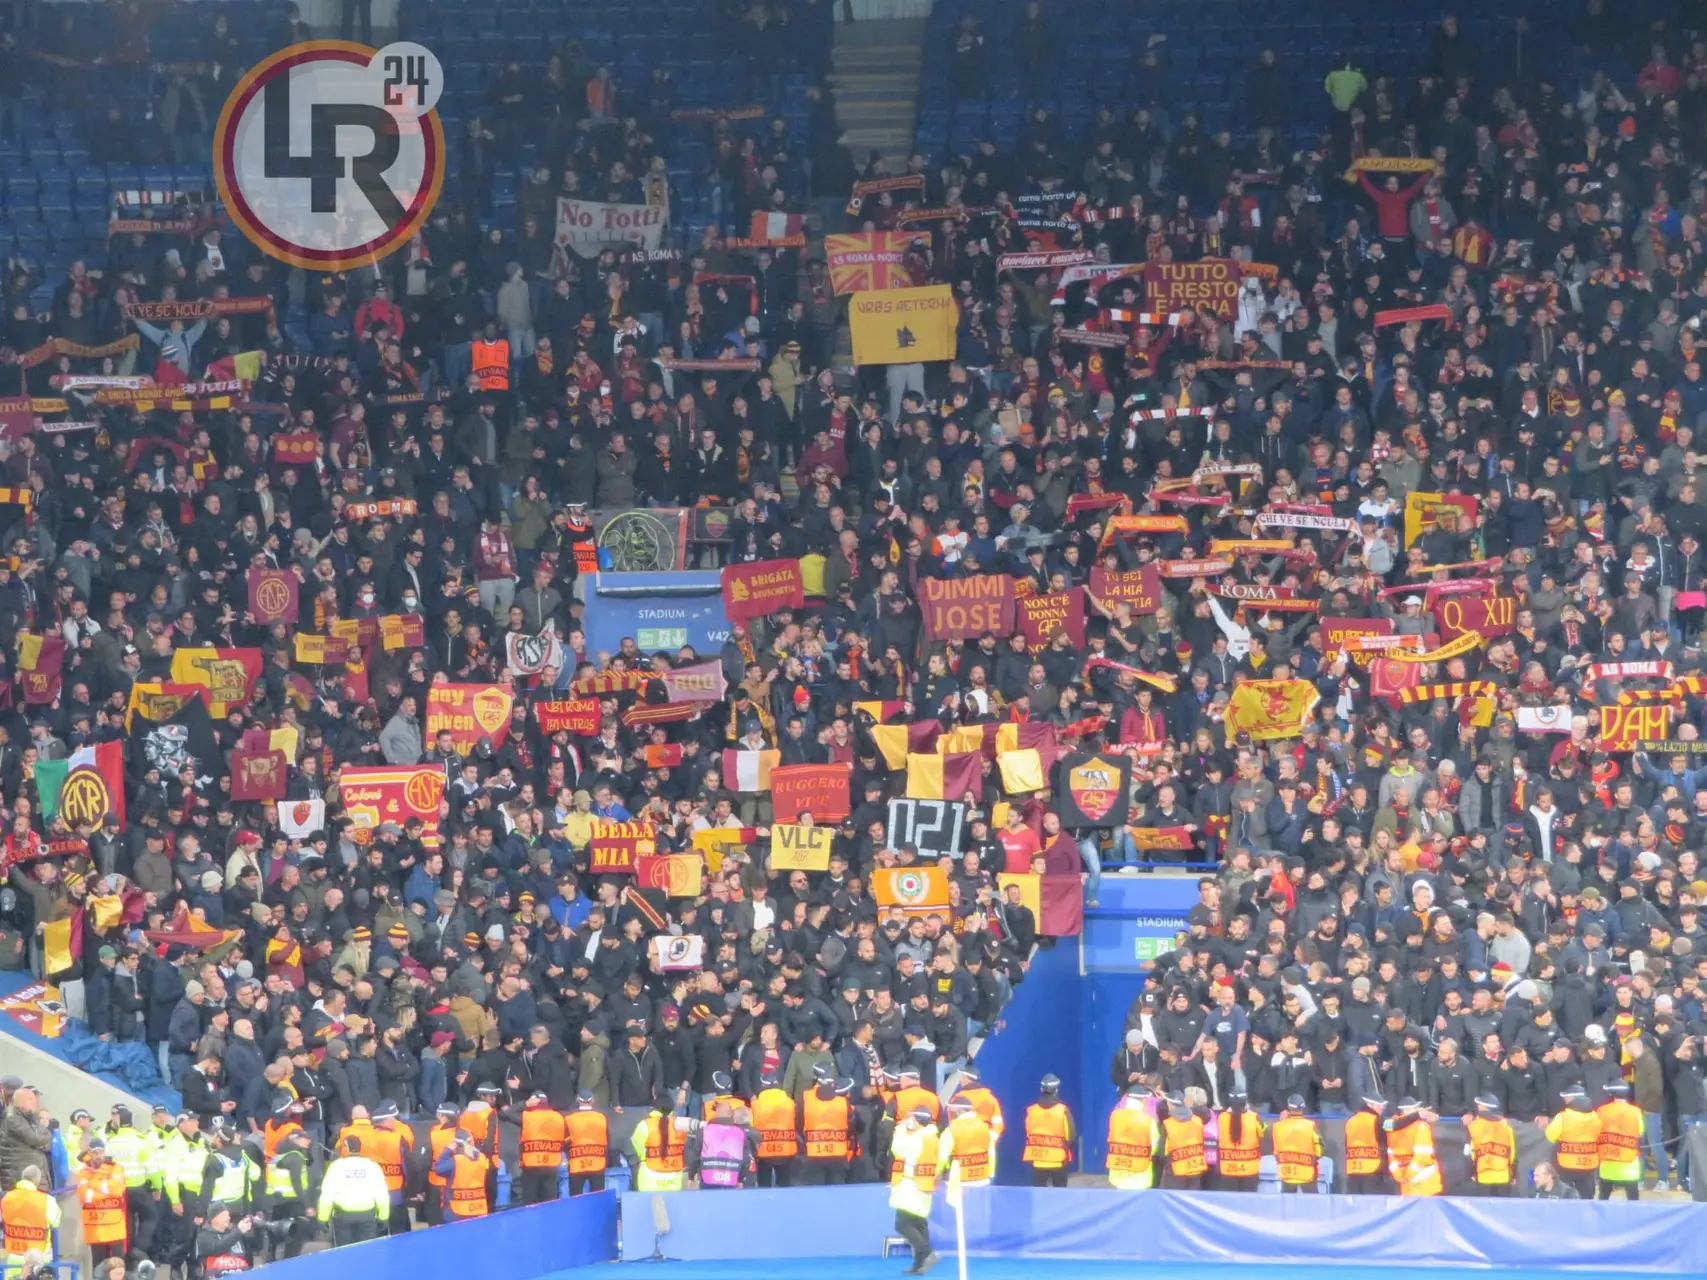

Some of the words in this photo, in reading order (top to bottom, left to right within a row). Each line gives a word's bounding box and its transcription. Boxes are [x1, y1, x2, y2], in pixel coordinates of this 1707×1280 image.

[560, 202, 593, 228] No
[600, 206, 661, 230] Totti
[632, 251, 645, 263] AS
[648, 250, 673, 261] ROMA
[846, 253, 875, 263] ROMA
[1158, 263, 1227, 280] TUTTO
[1147, 281, 1164, 298] IL
[1170, 281, 1238, 298] RESTO
[857, 301, 893, 314] URBS
[1155, 299, 1174, 315] E'
[1260, 516, 1275, 525] CHI
[1279, 517, 1293, 526] VE
[1295, 518, 1308, 526] SE
[751, 570, 794, 588] BRIGATA
[1123, 571, 1142, 582] SEI
[259, 582, 287, 609] ASR
[925, 574, 1005, 601] DIMMI
[1104, 587, 1120, 596] LA
[1123, 587, 1143, 596] MIA
[1220, 584, 1276, 599] ROMA
[1024, 599, 1048, 608] NON
[638, 608, 686, 619] STADIUM
[1028, 609, 1068, 620] DONNA
[706, 631, 731, 642] V42
[1621, 661, 1658, 674] ROMA
[430, 687, 464, 706] any
[429, 711, 474, 733] given
[560, 717, 595, 730] ULTRAS
[1601, 706, 1667, 740] DAM
[775, 777, 846, 794] RUGGERO
[65, 778, 102, 823] ASR
[593, 821, 655, 839] BELLA
[886, 799, 965, 859] 021
[778, 826, 823, 849] VLC
[593, 847, 630, 866] MIA
[1136, 917, 1185, 928] STADIUM
